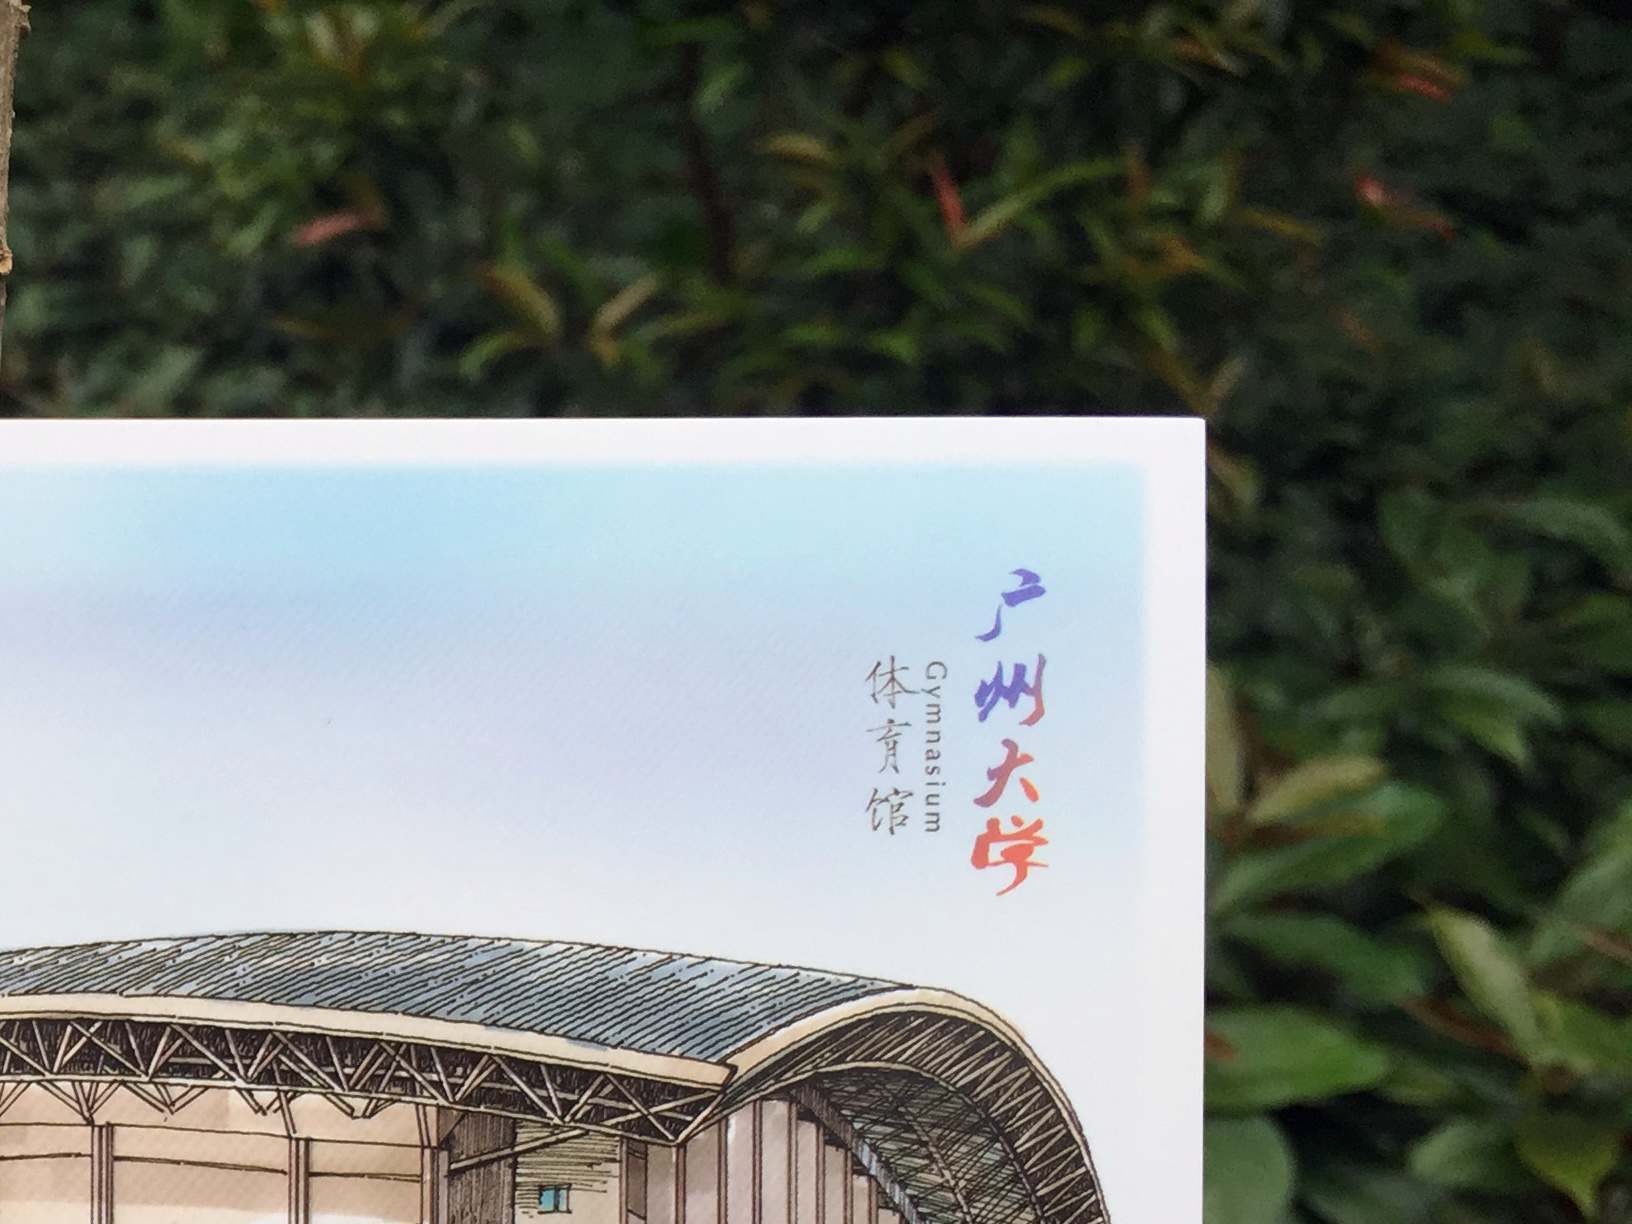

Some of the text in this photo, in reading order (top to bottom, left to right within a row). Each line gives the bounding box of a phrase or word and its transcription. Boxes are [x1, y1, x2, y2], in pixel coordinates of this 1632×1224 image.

[865, 654, 920, 836] 体育馆
[921, 660, 948, 833] Gymnasium
[971, 568, 1049, 897] 广州大学
